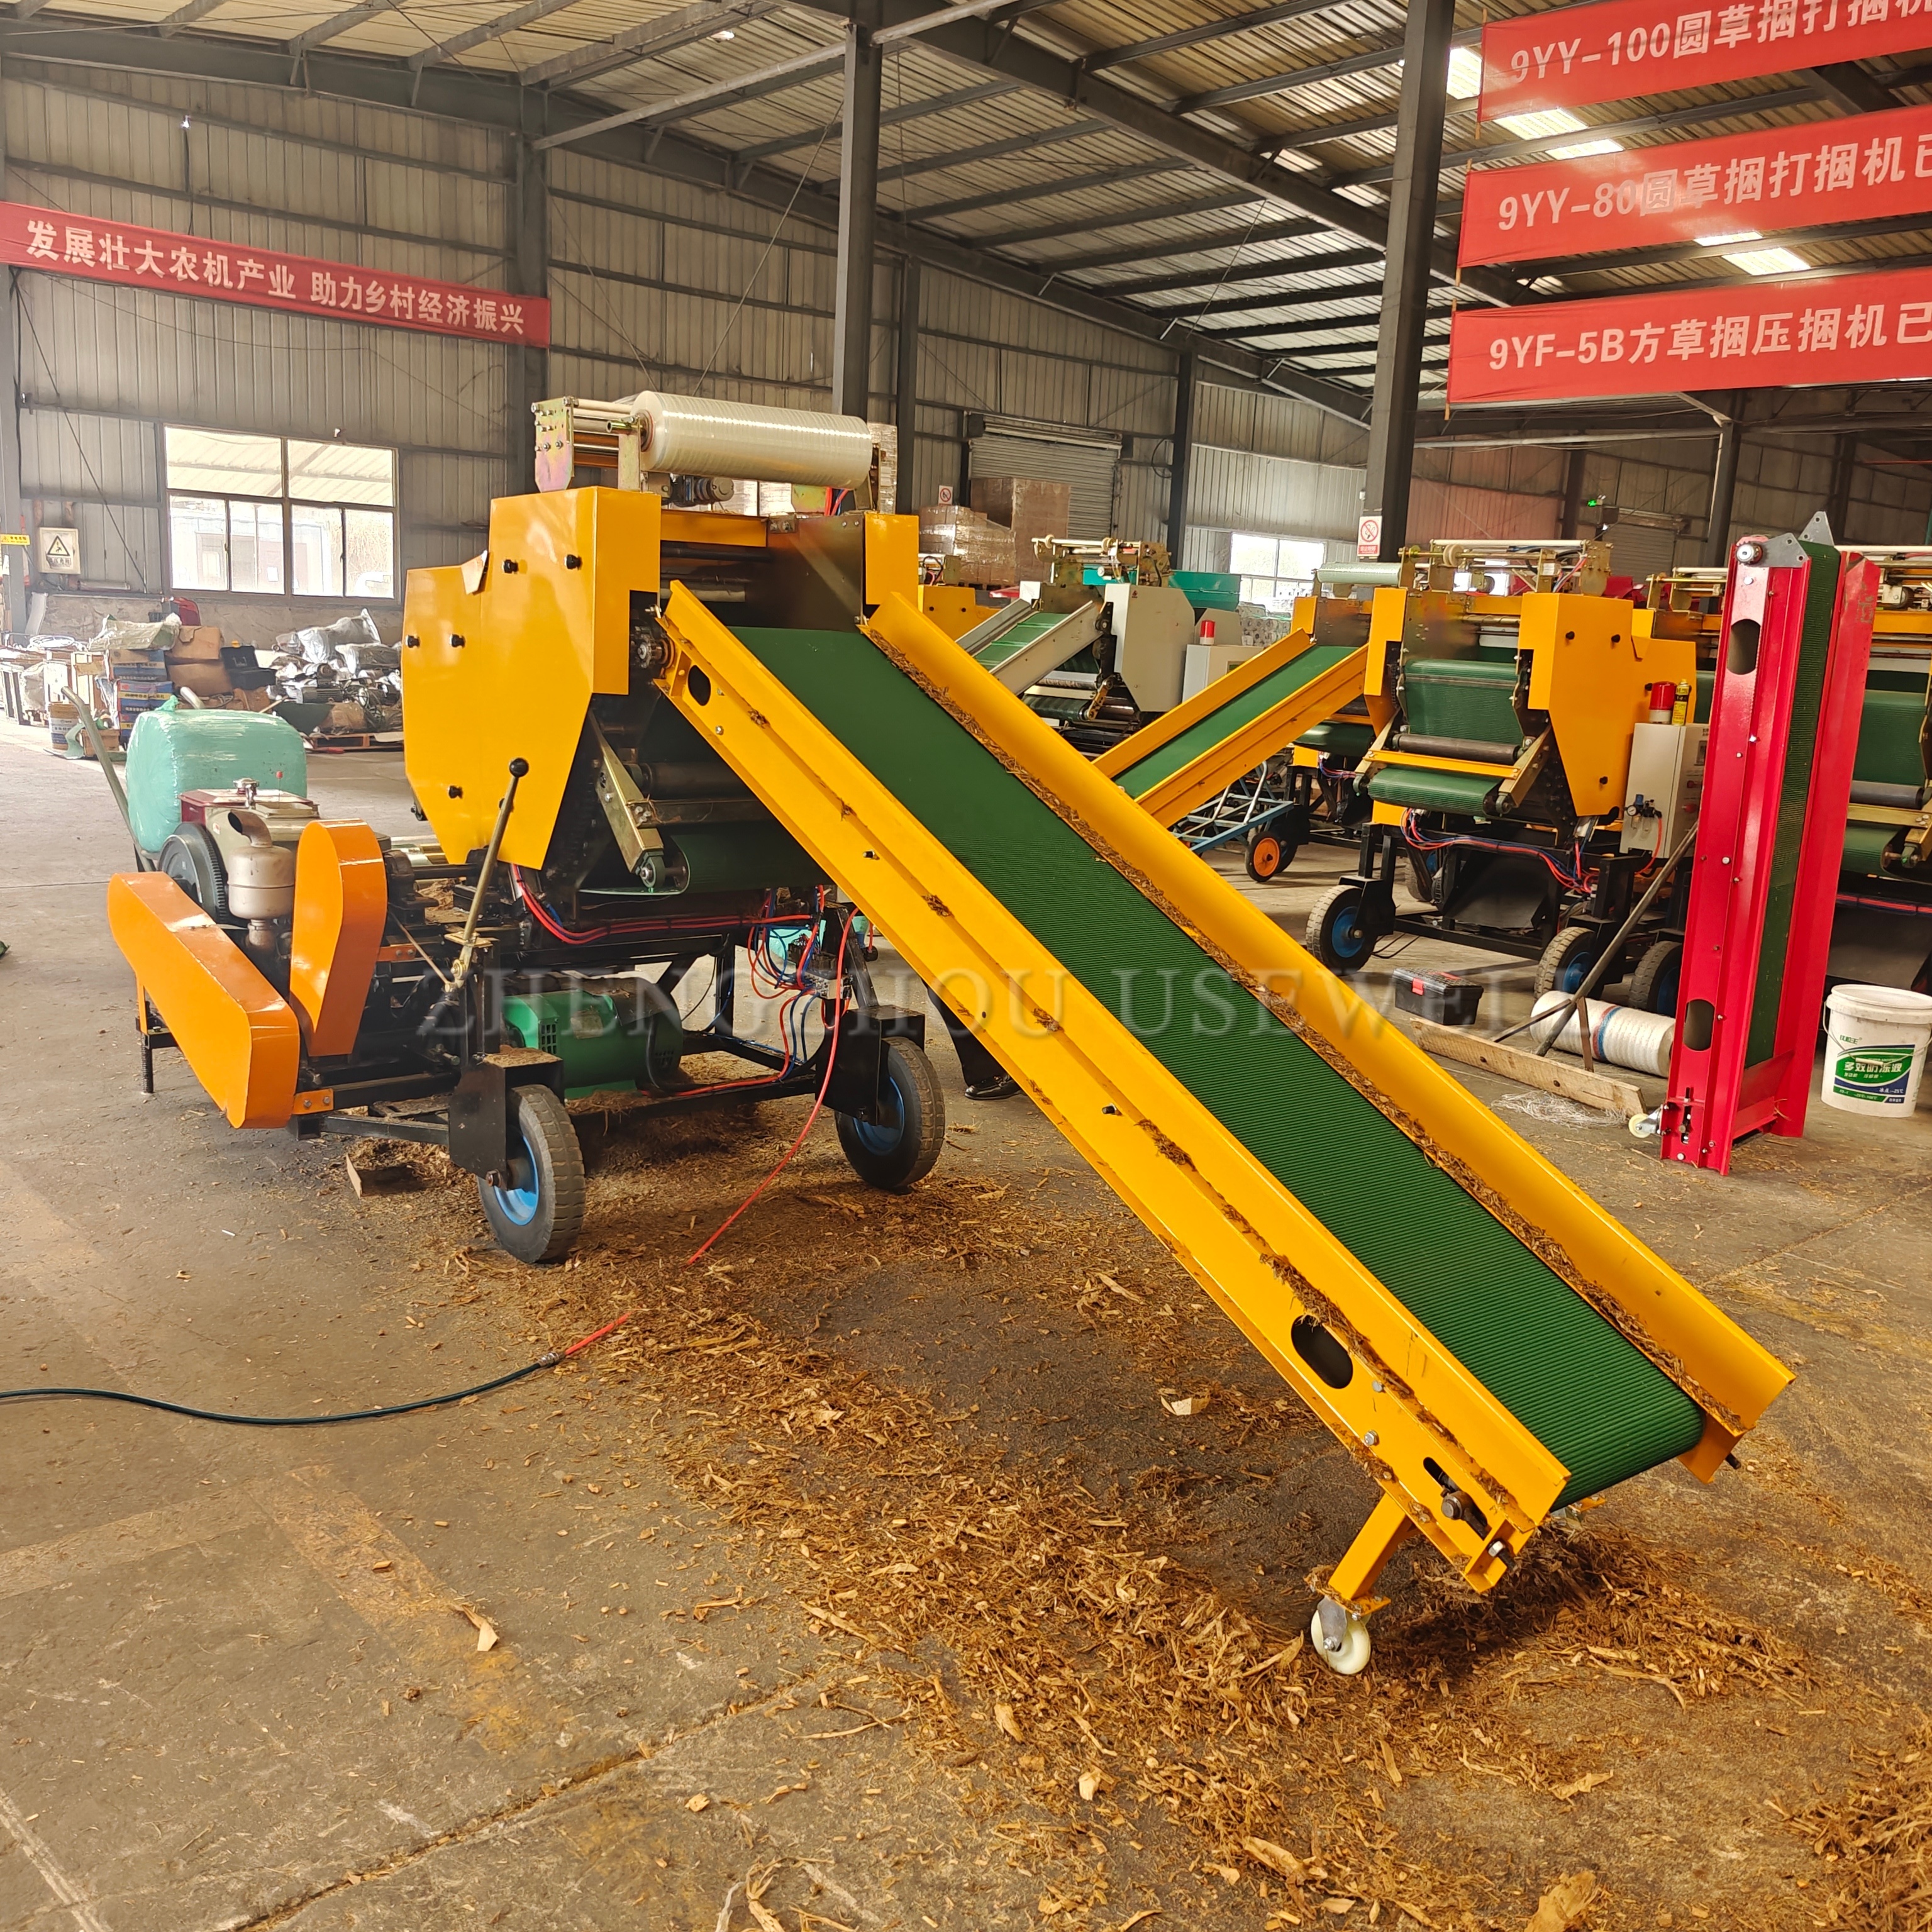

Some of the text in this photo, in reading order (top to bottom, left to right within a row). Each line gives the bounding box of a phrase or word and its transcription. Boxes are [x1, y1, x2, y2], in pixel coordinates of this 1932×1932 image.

[26, 220, 524, 335] 发展壮大农机产业 助力乡村经济振兴
[1489, 303, 1932, 370] 9YF-5B方草捆压捆机已
